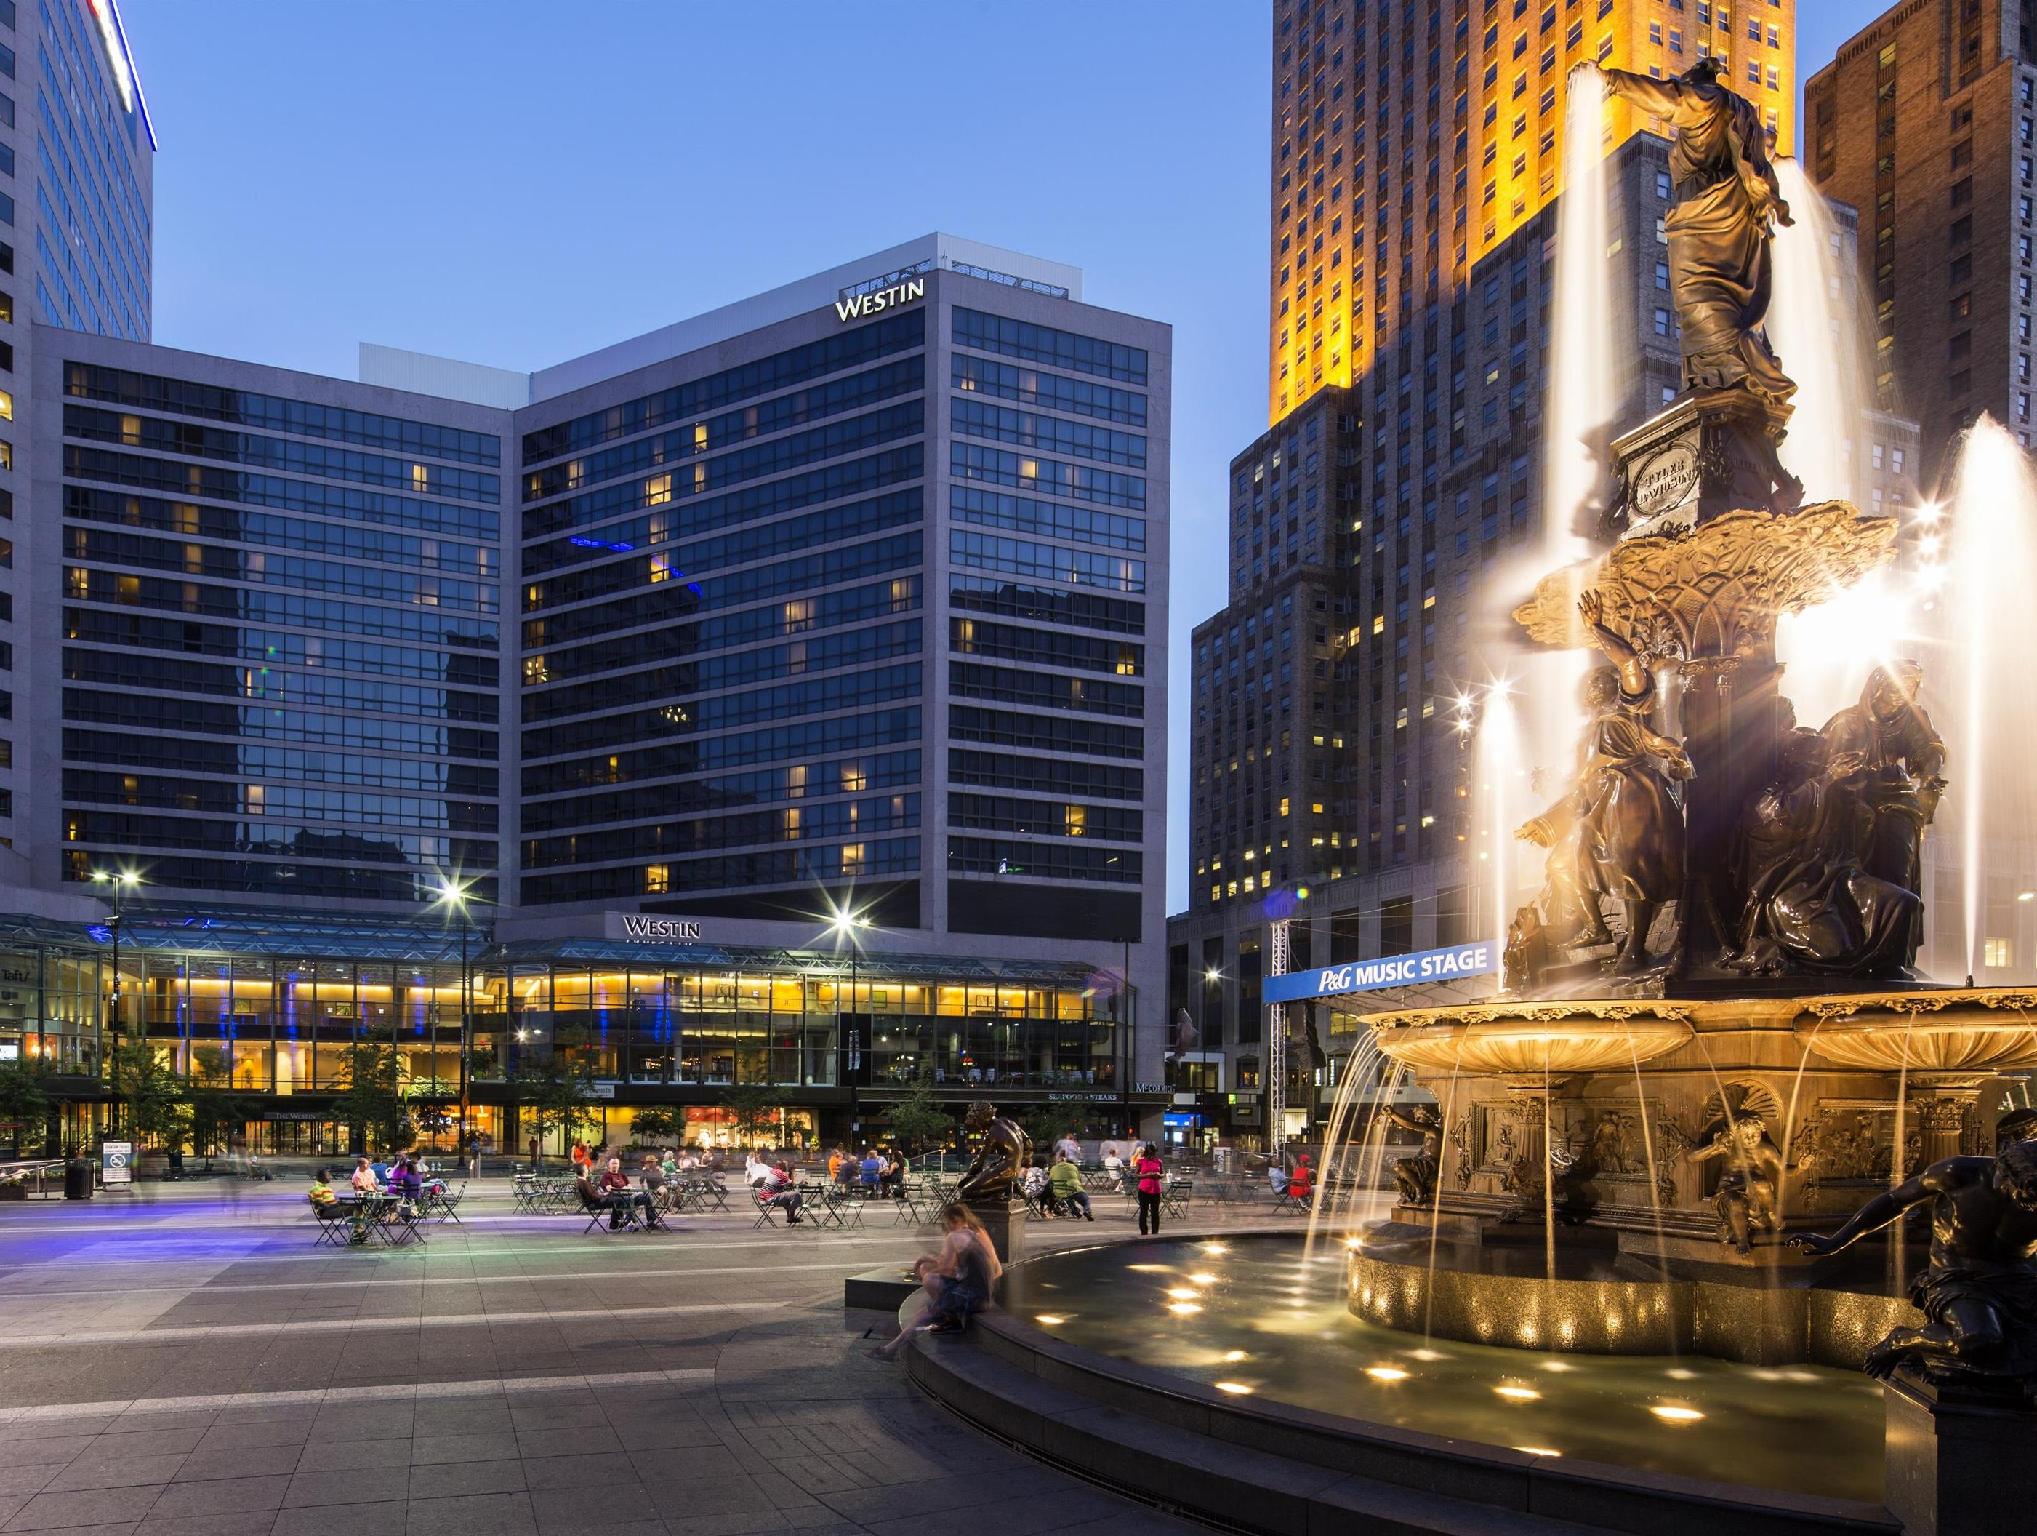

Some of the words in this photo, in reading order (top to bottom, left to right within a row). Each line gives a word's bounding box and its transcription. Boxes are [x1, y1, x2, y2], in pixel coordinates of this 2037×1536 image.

[834, 278, 925, 321] WESTIN
[623, 916, 700, 939] WESTIN
[1318, 967, 1352, 993] P&G
[1356, 959, 1416, 986] MUSIC
[1421, 948, 1488, 977] STAGE
